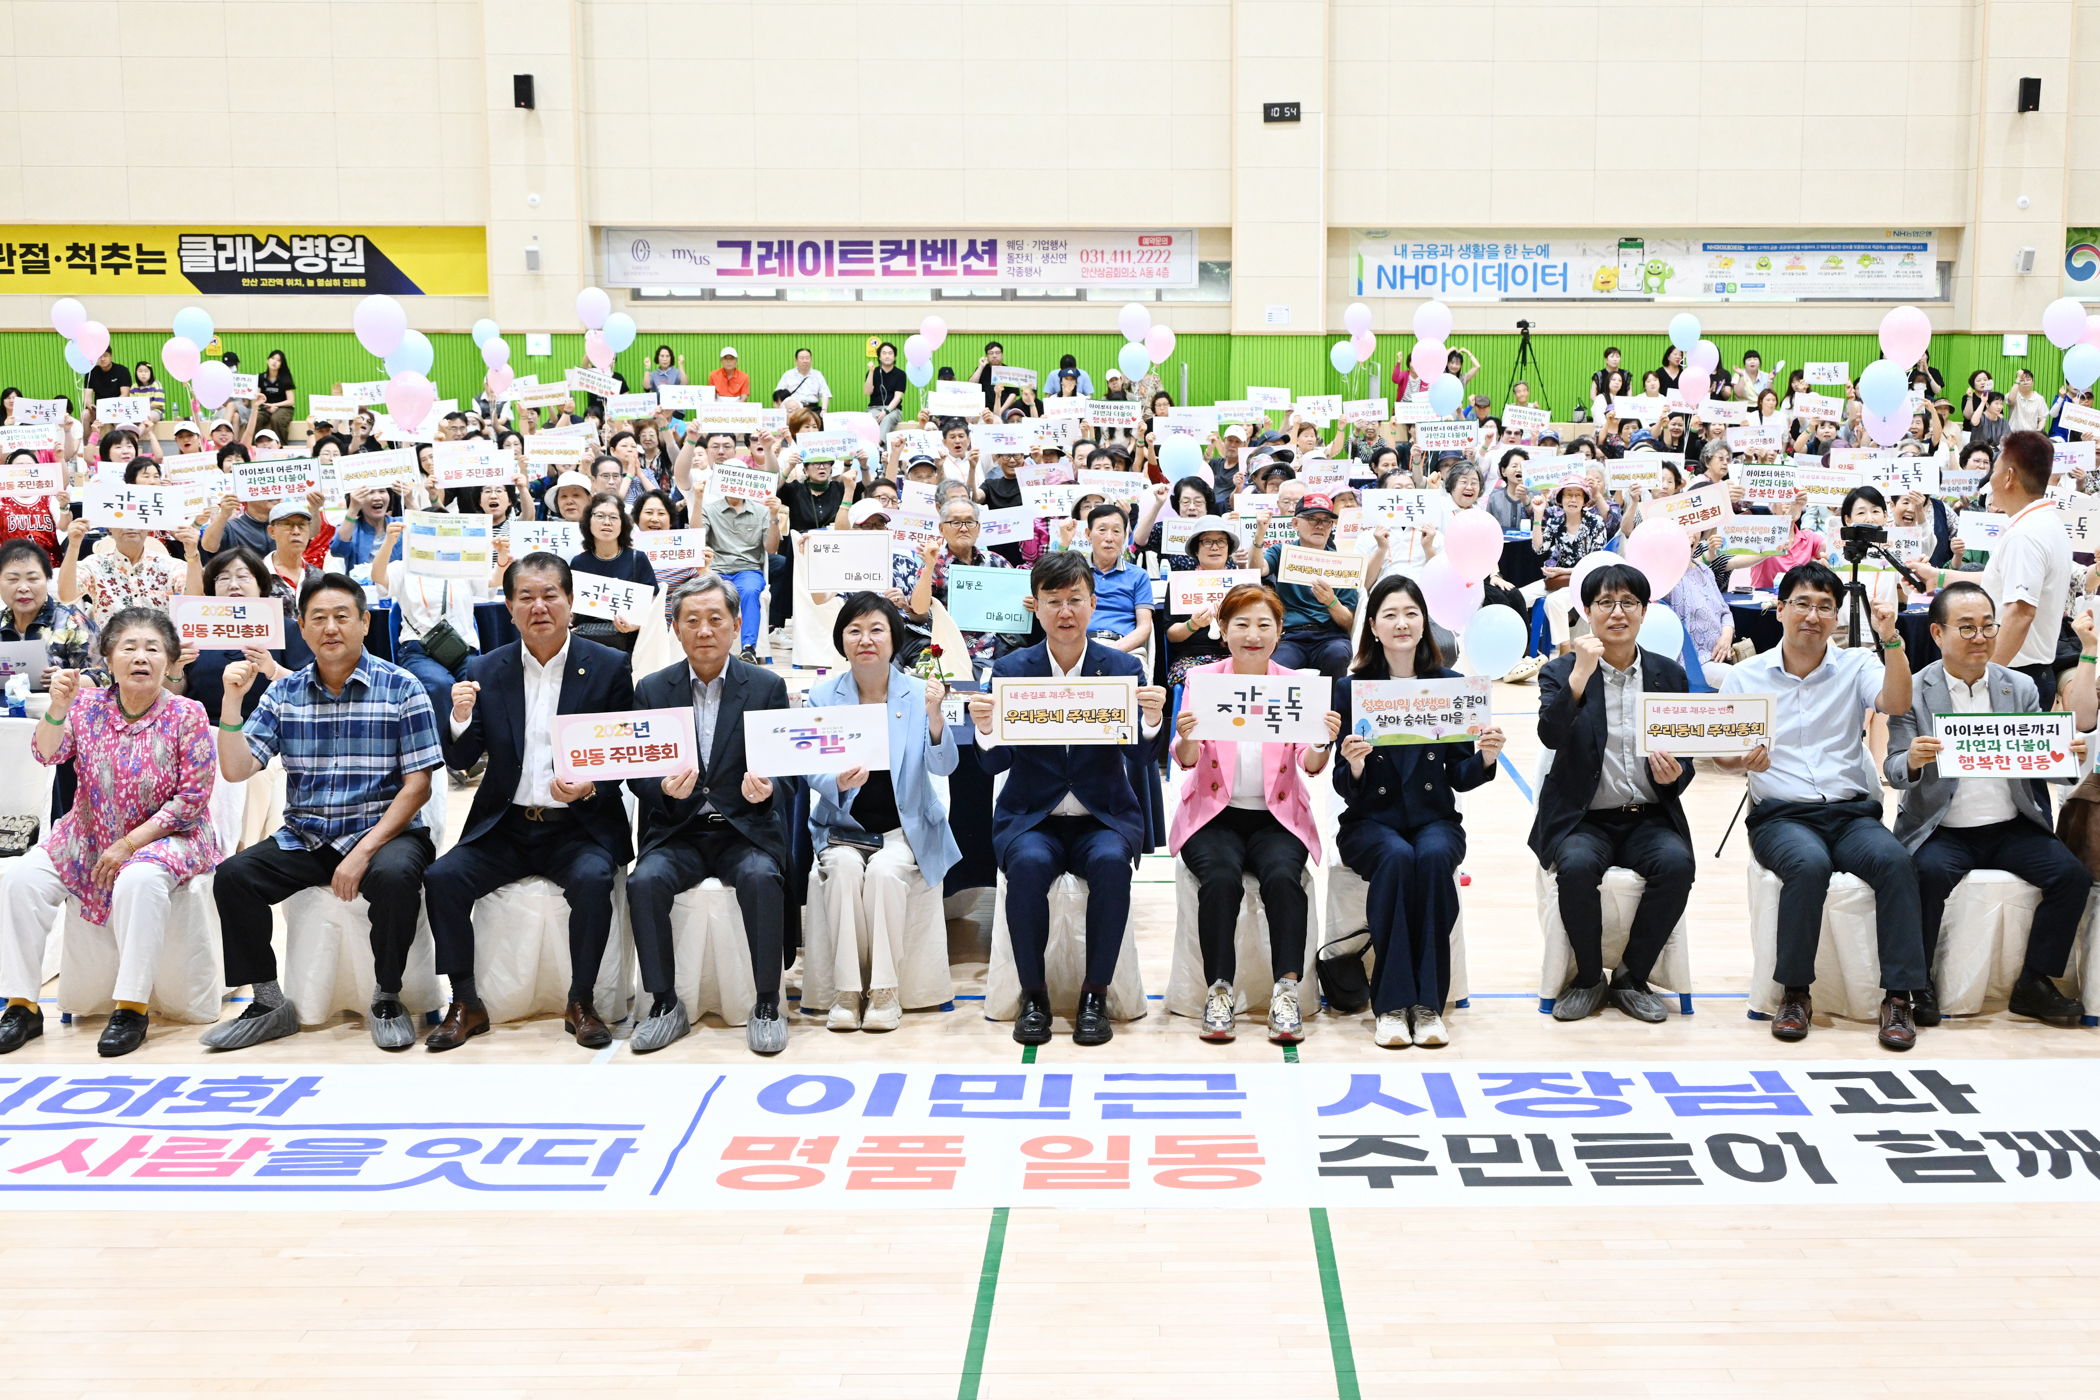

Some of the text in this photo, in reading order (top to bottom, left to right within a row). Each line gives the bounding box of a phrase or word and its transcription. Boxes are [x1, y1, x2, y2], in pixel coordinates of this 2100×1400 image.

[1007, 239, 1067, 250] 웨딩 기업행사
[1143, 237, 1168, 245] 예약문의
[179, 235, 366, 274] 클래스병원
[1080, 249, 1171, 264] 031.411.2222
[1394, 243, 1550, 259] 내 금융과 생활을 한 눈에
[716, 238, 998, 278] 그레이트컨벤션
[1007, 253, 1067, 264] 돌잔치 생신연
[1007, 267, 1042, 277] 각종행사
[1081, 267, 1170, 278] 안산상공회의소 A동 4층
[1377, 262, 1568, 292] NH마이데이터
[242, 278, 258, 286] 안산
[260, 278, 284, 286] 고잔역
[317, 278, 340, 286] 열심히
[458, 456, 489, 465] 2025년
[9, 469, 39, 478] 2025년
[239, 463, 311, 476] 아이부터 어른까지
[444, 468, 504, 480] 일동 주민총회
[718, 468, 772, 482] 아이부터 어른까지
[1746, 469, 1796, 478] 아이부터 어른까지
[17, 480, 54, 490] 주민총회
[247, 474, 306, 485] 자연과 더불어
[721, 476, 767, 490] 자연과 더불어
[1750, 478, 1794, 488] 자연과 더불어
[248, 483, 307, 497] 행복한 일동
[720, 484, 765, 498] 행복한 일동
[1749, 488, 1794, 499] 행복한 일동
[1666, 495, 1702, 513] 2025년
[1679, 505, 1721, 526] 주민총회
[7, 514, 53, 532] BULLS
[904, 518, 933, 530] 2025년
[1723, 525, 1788, 534] 성호이익 선생의 숨결이
[653, 537, 682, 546] 2025년
[1729, 535, 1776, 545] 살아 숨쉬는 마을
[1895, 540, 1918, 549] 숨결이
[660, 549, 695, 561] 주민총회
[813, 543, 841, 554] 일동은
[844, 572, 884, 582] 마을이다.
[1197, 577, 1233, 588] 2025년
[956, 580, 983, 591] 일동은
[1181, 592, 1203, 605] 일동
[201, 605, 247, 619] 2025년
[986, 611, 1025, 623] 마을이다.
[181, 623, 270, 638] 일동 주민총회
[1021, 691, 1047, 699] 손길로
[1049, 691, 1076, 699] 채우는
[1077, 691, 1094, 699] 변화
[1361, 695, 1487, 712] 성호이익 선생의 숨결이
[1652, 706, 1735, 714] 내 손길로 채우는 변화
[1005, 708, 1126, 723] 우리동네 주민총회
[1376, 712, 1464, 727] 살아 숨쉬는 마을
[593, 720, 651, 740] 2025년
[1648, 722, 1765, 737] 우리동네 주민총회
[1945, 723, 2060, 737] 아이부터 어른까지
[1956, 739, 2051, 752] 자연과 더불어
[570, 742, 679, 768] 일동 주민총회
[1958, 755, 2051, 770] 행복한 일동
[755, 1069, 1981, 1120] 이민근 시장님과
[7, 1134, 640, 1189] 사람을 잇다
[716, 1135, 967, 1191] 명품
[1019, 1134, 1267, 1190] 일동
[1317, 1132, 1839, 1189] 주민들이
